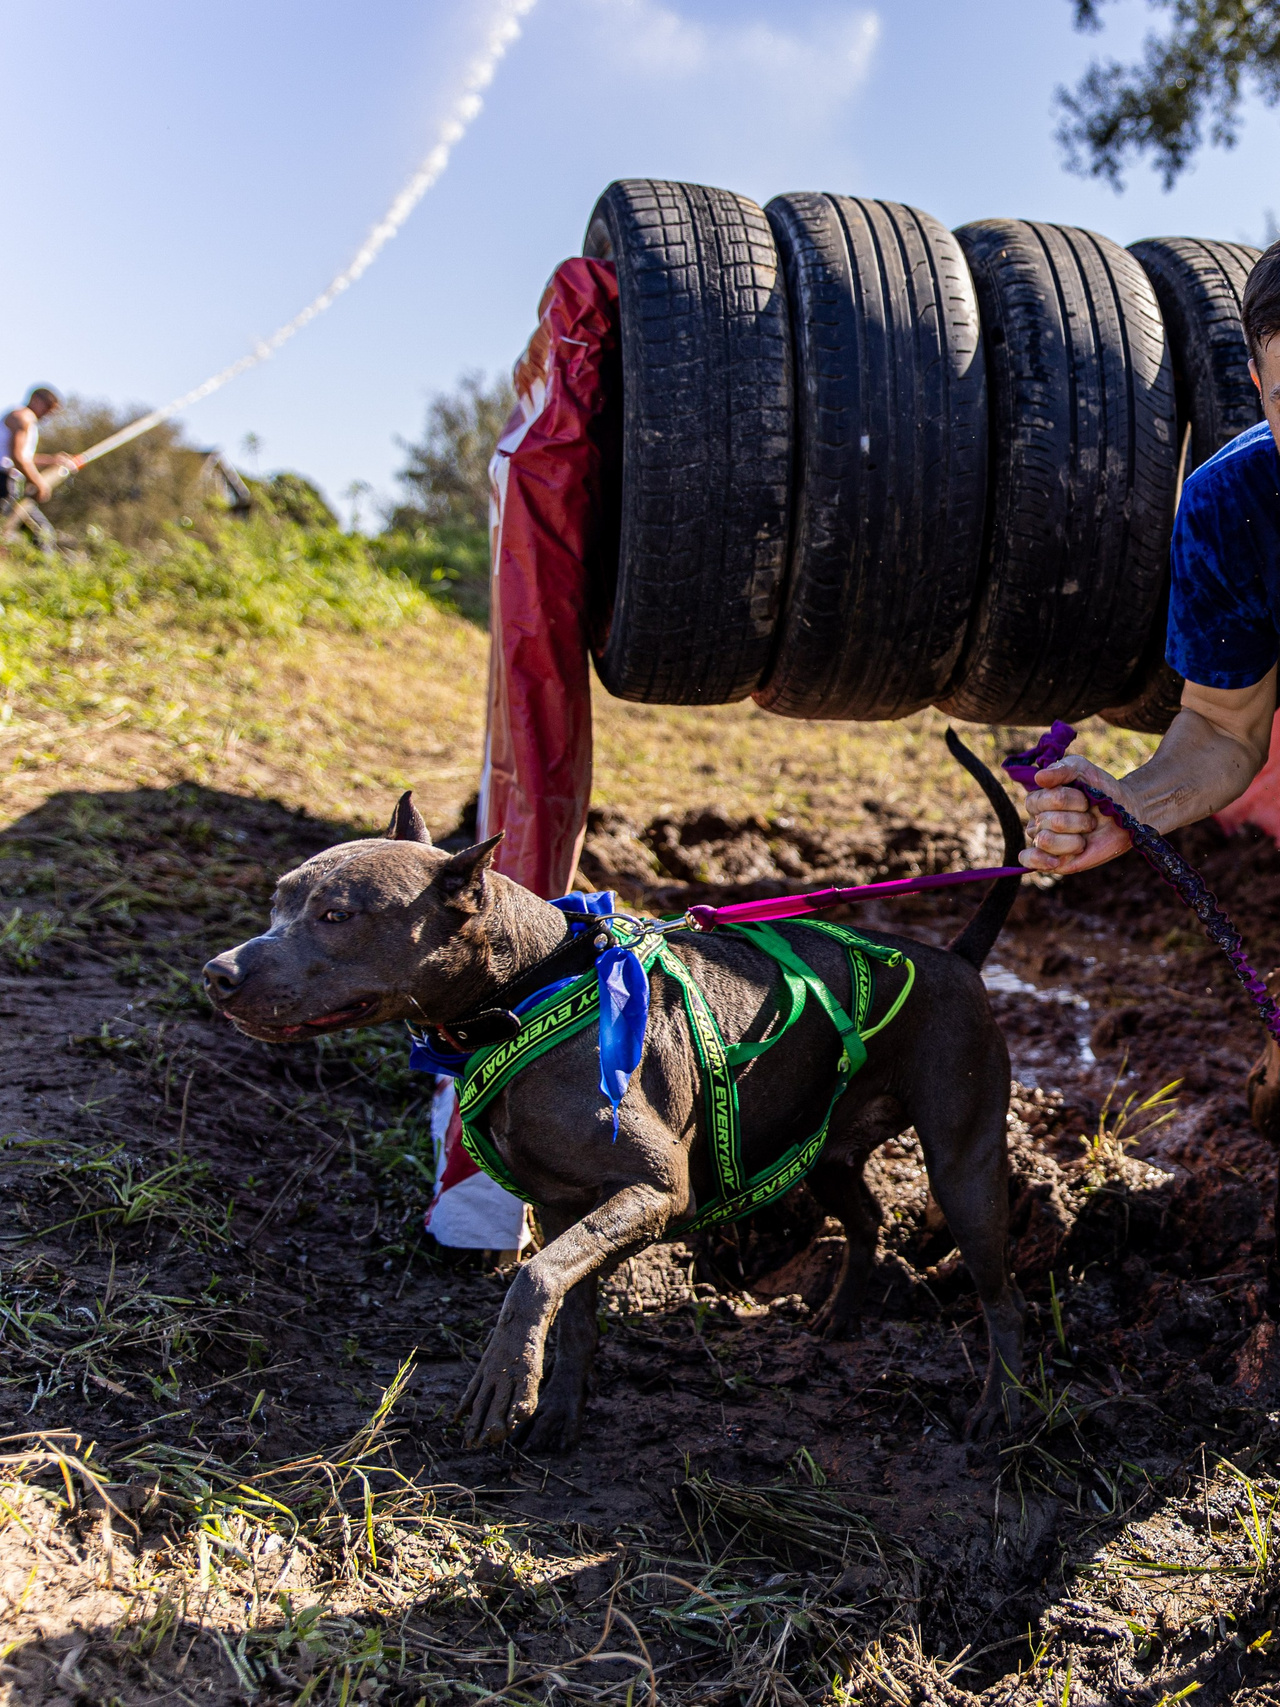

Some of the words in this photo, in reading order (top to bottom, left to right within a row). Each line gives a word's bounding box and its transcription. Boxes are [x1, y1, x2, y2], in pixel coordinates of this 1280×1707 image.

[853, 949, 869, 1034] VERYDA
[482, 1003, 572, 1085] EVERYDAY
[714, 1085, 736, 1190] EVERYDAY
